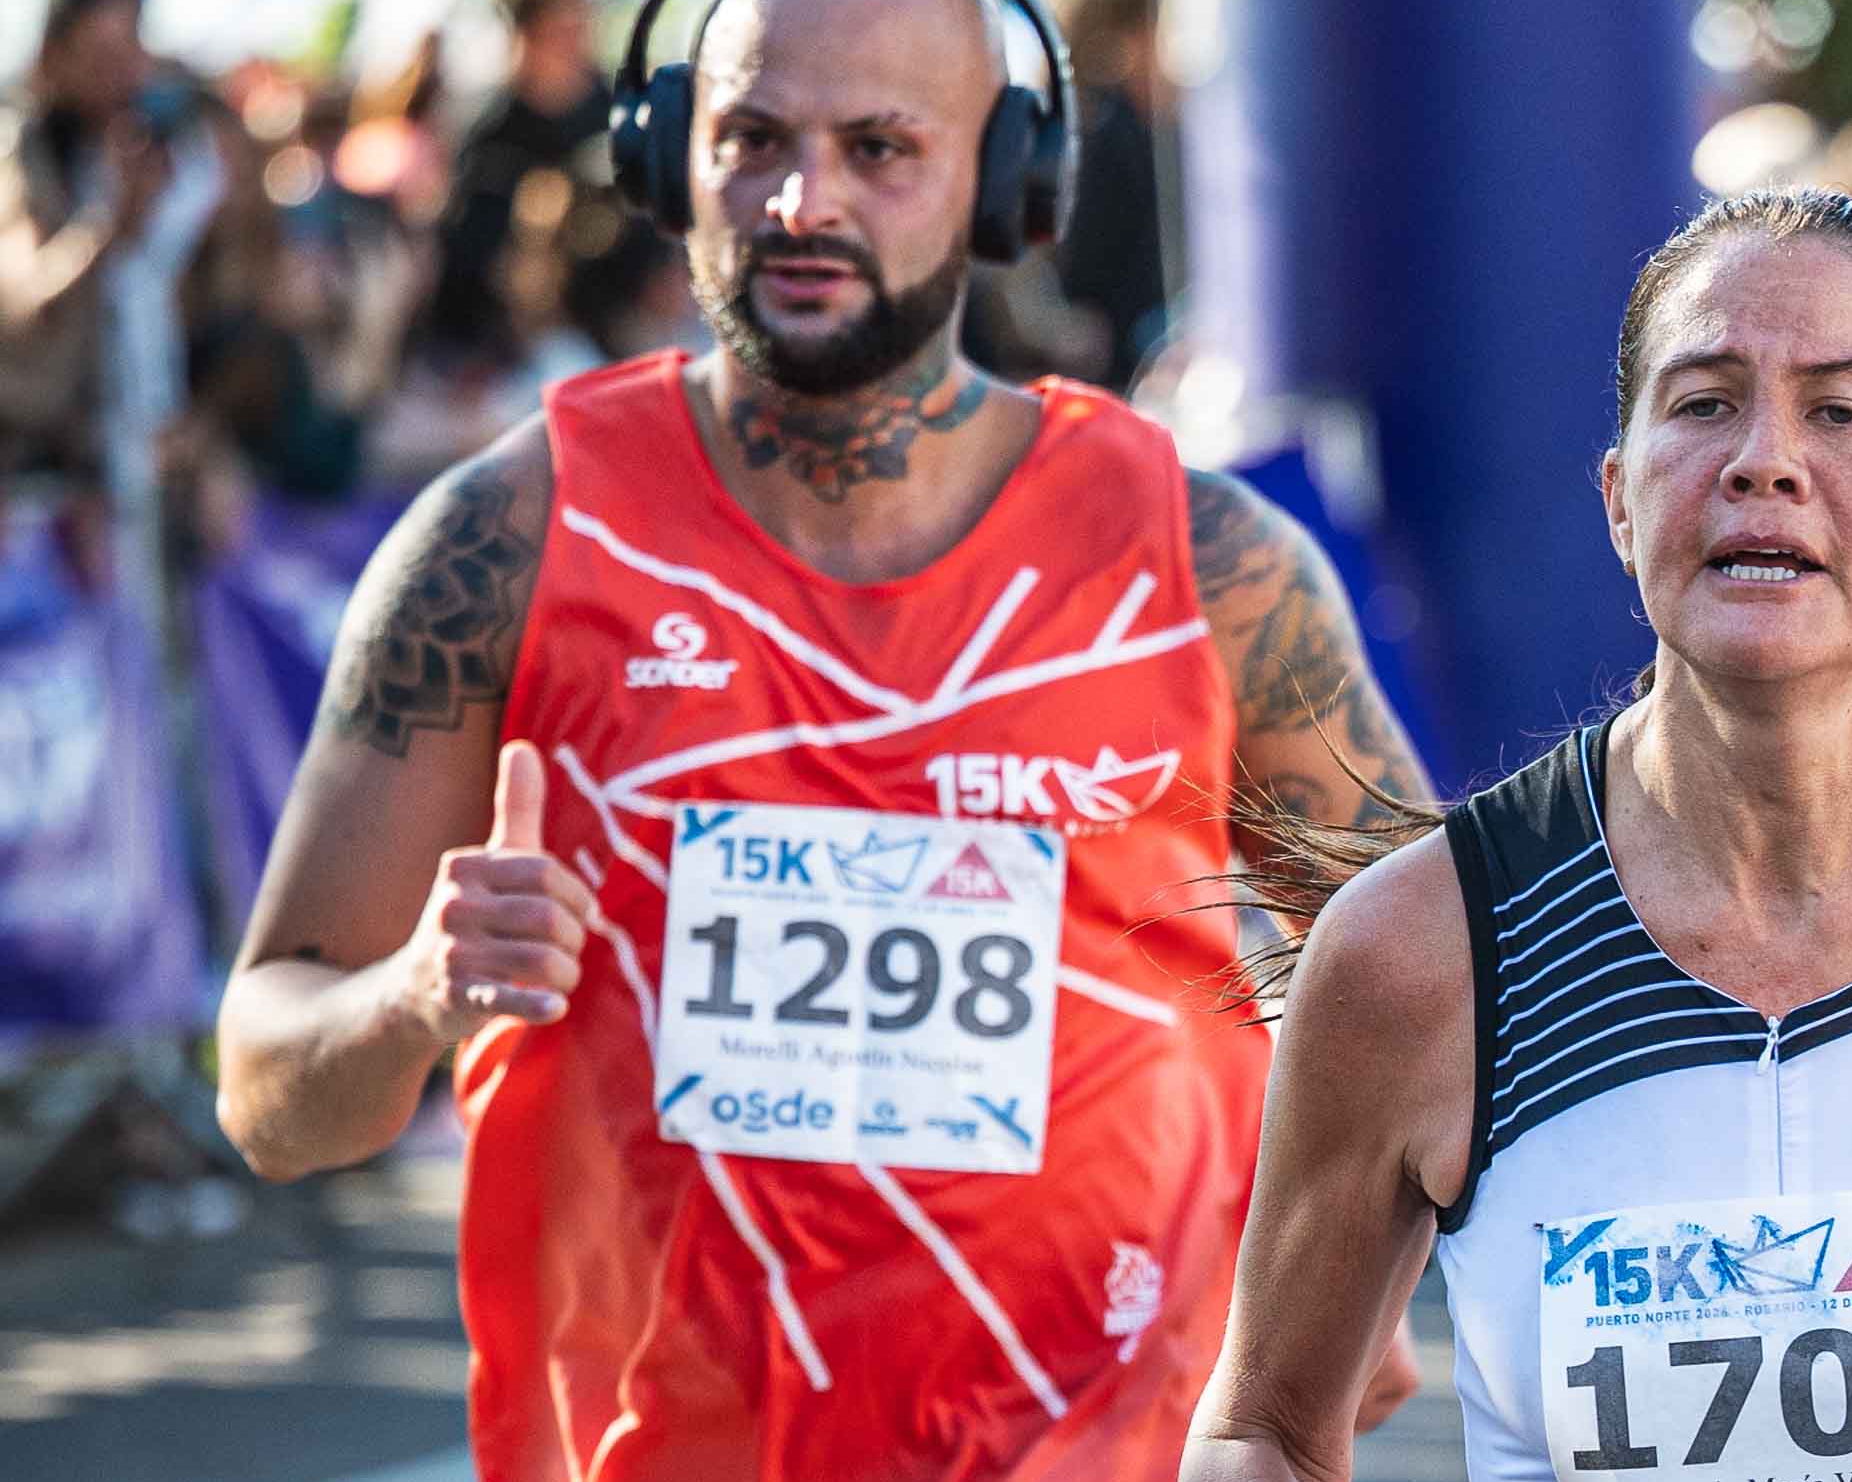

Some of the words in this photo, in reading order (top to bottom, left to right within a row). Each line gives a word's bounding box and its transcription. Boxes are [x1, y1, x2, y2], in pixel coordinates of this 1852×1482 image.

[925, 752, 1056, 819] 15K
[714, 836, 815, 884] 15K
[684, 914, 1034, 1038] 1298
[710, 1089, 834, 1132] osde
[1584, 1242, 1706, 1308] 15K
[1586, 1313, 1640, 1328] PUERTO
[1645, 1309, 1691, 1323] NORTE
[1823, 1298, 1838, 1310] 12
